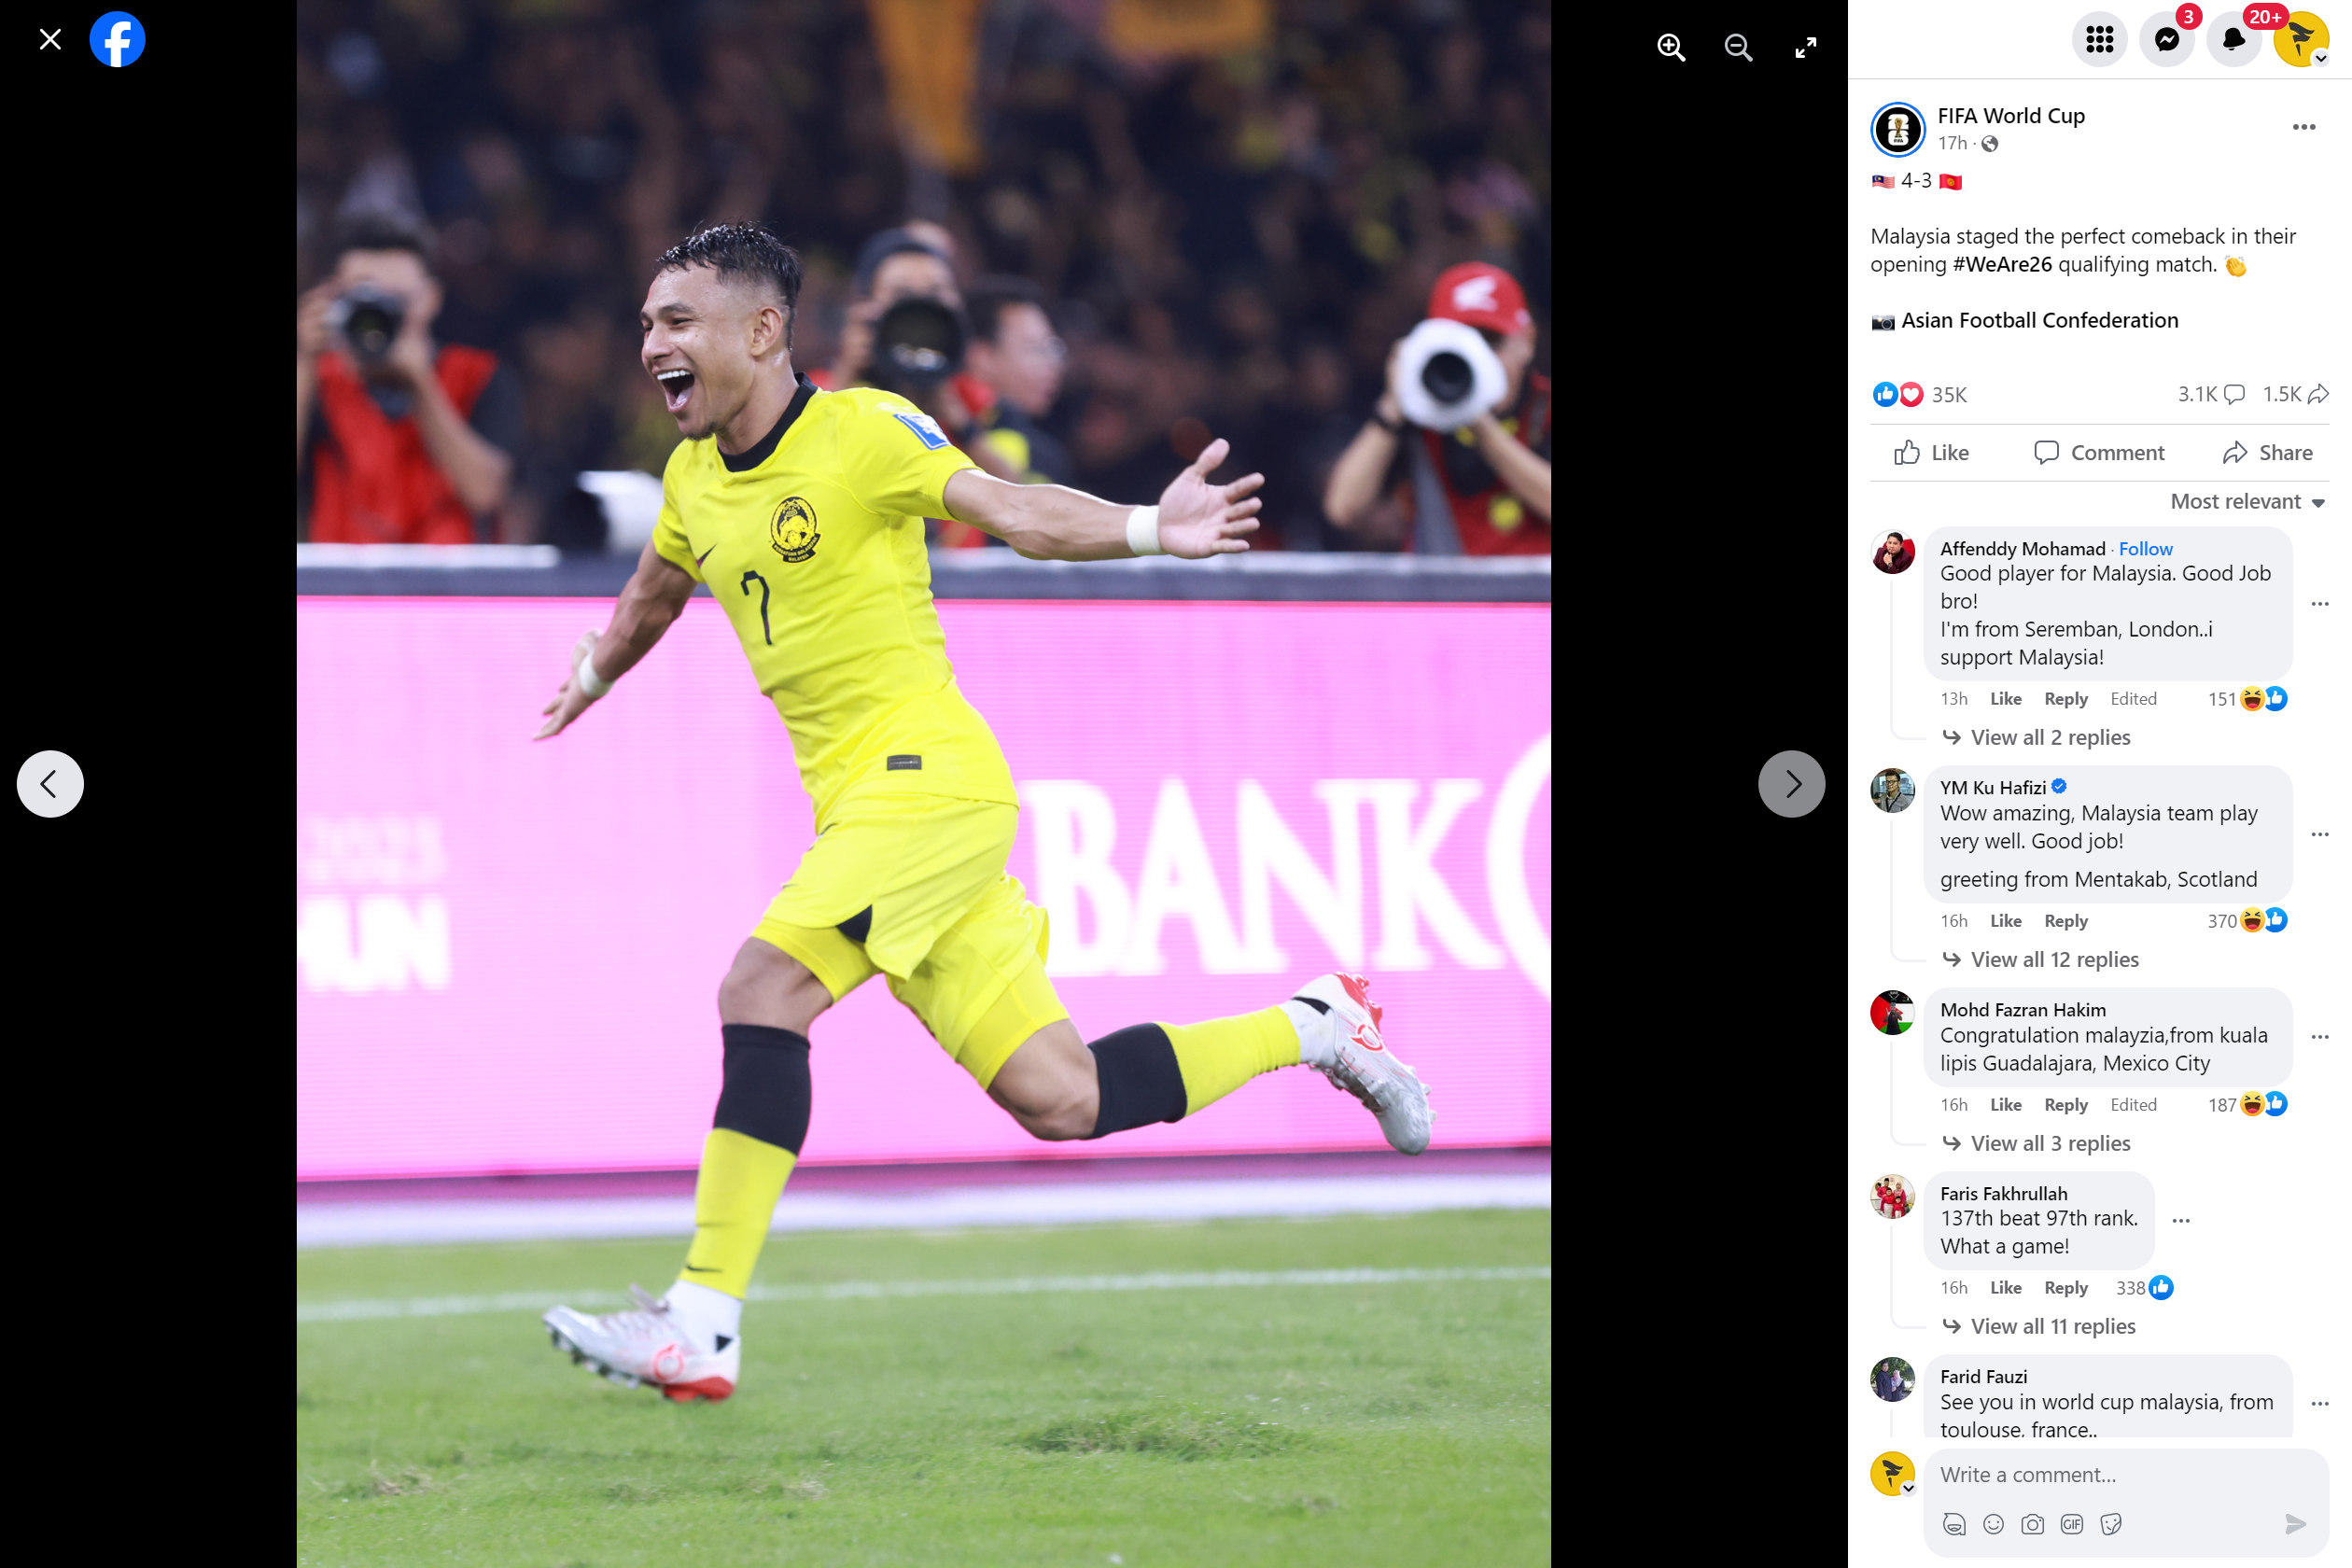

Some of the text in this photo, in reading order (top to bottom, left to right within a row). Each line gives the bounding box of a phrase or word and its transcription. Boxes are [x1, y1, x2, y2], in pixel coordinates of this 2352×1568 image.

[2184, 10, 2193, 23] 3
[2250, 10, 2282, 23] 20+
[1939, 107, 2085, 128] FIFA World Cup
[1939, 135, 1967, 149] 17h
[1901, 173, 1931, 188] 4-3
[1872, 228, 2296, 248] Malaysia staged the perfect comeback in their
[1871, 256, 2217, 276] opening #WeAre26 qualifying match.
[1901, 312, 2178, 328] Asian Football Confederation
[1933, 387, 1967, 402] 35K
[2179, 386, 2218, 401] 3.1K
[2264, 386, 2302, 401] 1.5K
[1933, 444, 1968, 460] Like
[2072, 445, 2164, 460] Comment
[2261, 444, 2313, 460] Share
[2172, 493, 2301, 509] Most relevant
[1940, 541, 2106, 561] Affenddy Mohamad
[2121, 541, 2174, 555] Follow
[788, 553, 810, 562] MALAYSIA
[1941, 565, 2271, 585] Good player for Malaysia. Good Job
[740, 570, 773, 646] 7
[1942, 593, 1977, 609] bro!
[1942, 621, 2212, 639] I'm from Seremban, London..i
[1941, 649, 2103, 669] support Malaysia!
[1942, 692, 1967, 705] 13h
[1992, 692, 2022, 705] Like
[2046, 692, 2089, 708] Reply
[2112, 692, 2156, 705] Edited
[2210, 693, 2234, 706] 151
[1971, 729, 2131, 749] View all 2 replies
[1940, 780, 2046, 794] YM Ku Hafizi
[1940, 805, 2258, 825] Wow amazing, Malaysia team play
[1940, 833, 2122, 853] very well. Good job!
[1022, 773, 1505, 977] BANK
[1941, 871, 2257, 891] greeting from Mentakab, Scotland
[1942, 914, 1967, 927] 16h
[1992, 914, 2022, 927] Like
[2046, 914, 2089, 931] Reply
[2209, 915, 2237, 928] 370
[1971, 951, 2139, 972] View all 12 replies
[1941, 1002, 2106, 1016] Mohd Fazran Hakim
[1941, 1027, 2267, 1047] Congratulation malayzia,from kuala
[1942, 1055, 2210, 1075] lipis Guadalajara, Mexico City
[1942, 1098, 1967, 1111] 16h
[1992, 1098, 2022, 1111] Like
[2046, 1098, 2089, 1114] Reply
[2112, 1098, 2156, 1111] Edited
[2210, 1099, 2236, 1112] 187
[1971, 1135, 2131, 1156] View all 3 replies
[1941, 1186, 2067, 1200] Faris Fakhrullah
[1942, 1210, 2137, 1225] 137th beat 97th rank.
[1940, 1238, 2068, 1258] What a game!
[1942, 1281, 1967, 1294] 16h
[1992, 1281, 2022, 1294] Like
[2046, 1281, 2089, 1297] Reply
[2118, 1281, 2146, 1295] 338
[1971, 1318, 2135, 1339] View all 11 replies
[1941, 1369, 2027, 1383] Farid Fauzi
[1941, 1393, 2273, 1415] See you in world cup malaysia, from
[2032, 1421, 2096, 1437] france..
[1940, 1466, 1990, 1482] Write
[1997, 1471, 2006, 1482] a
[2064, 1518, 2081, 1532] GIF
